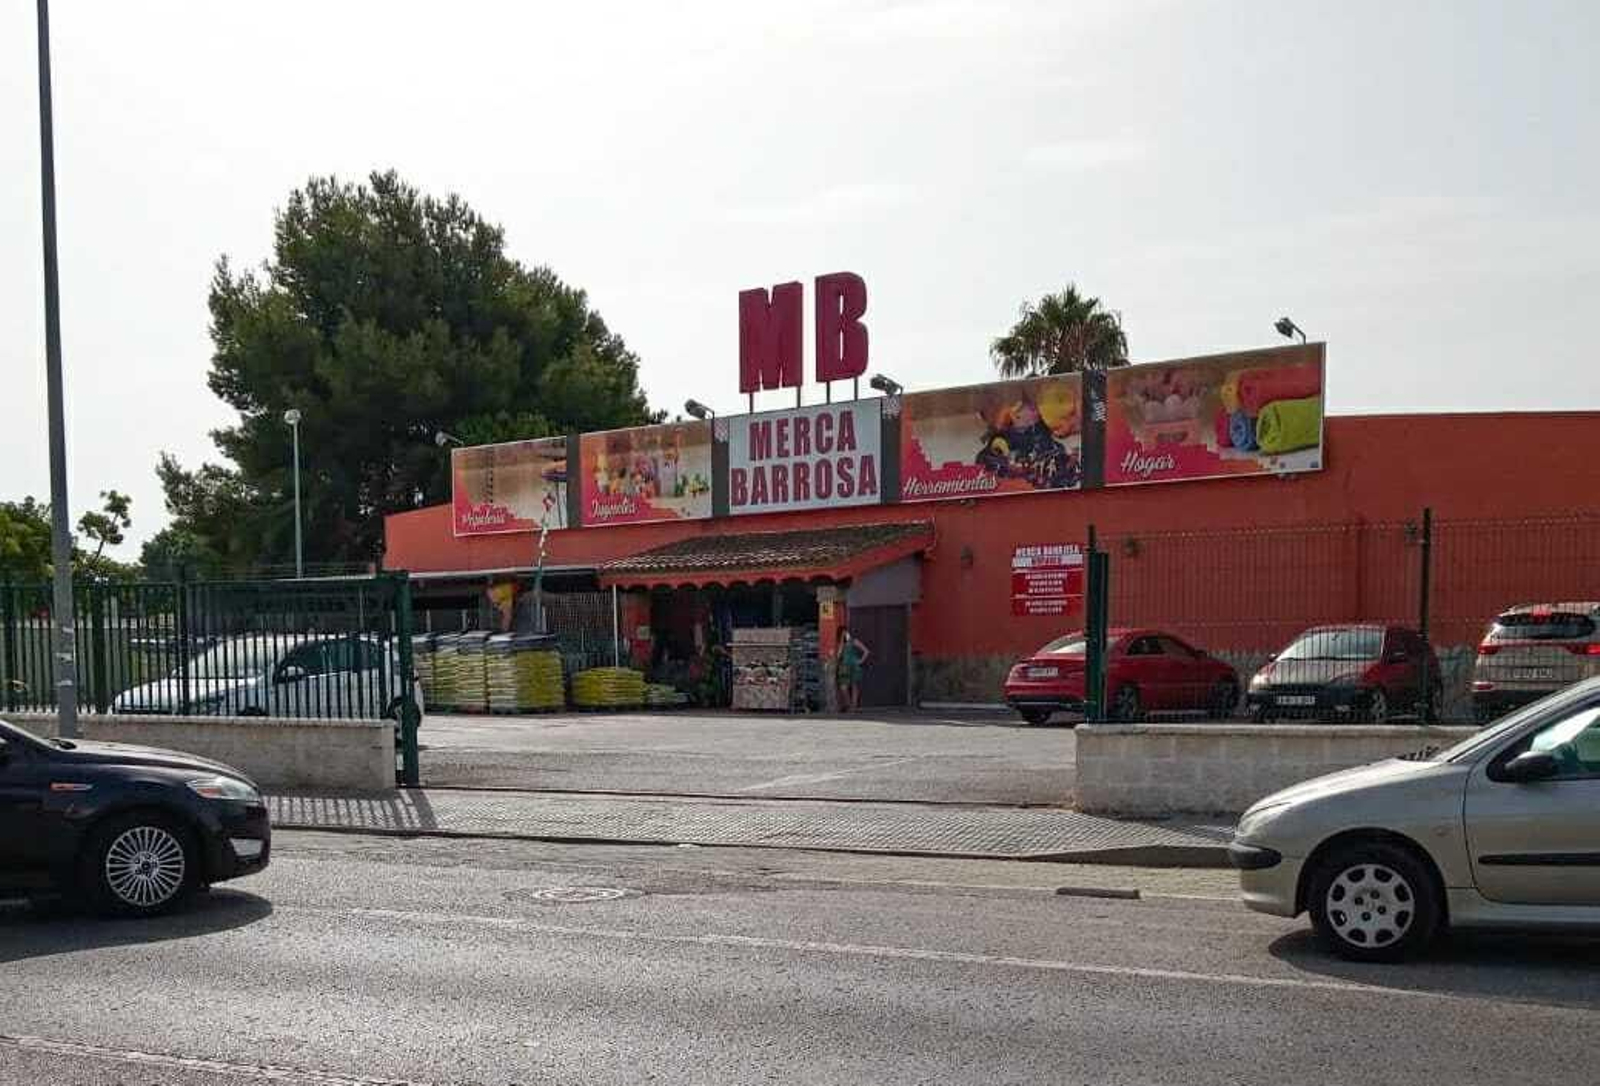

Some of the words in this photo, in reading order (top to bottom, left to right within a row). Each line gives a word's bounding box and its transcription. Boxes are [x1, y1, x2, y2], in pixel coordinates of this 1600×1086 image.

[749, 410, 855, 460] MERCA
[731, 456, 877, 506] BARROSA
[1121, 450, 1174, 476] Hogar
[904, 471, 998, 494] Herramientas
